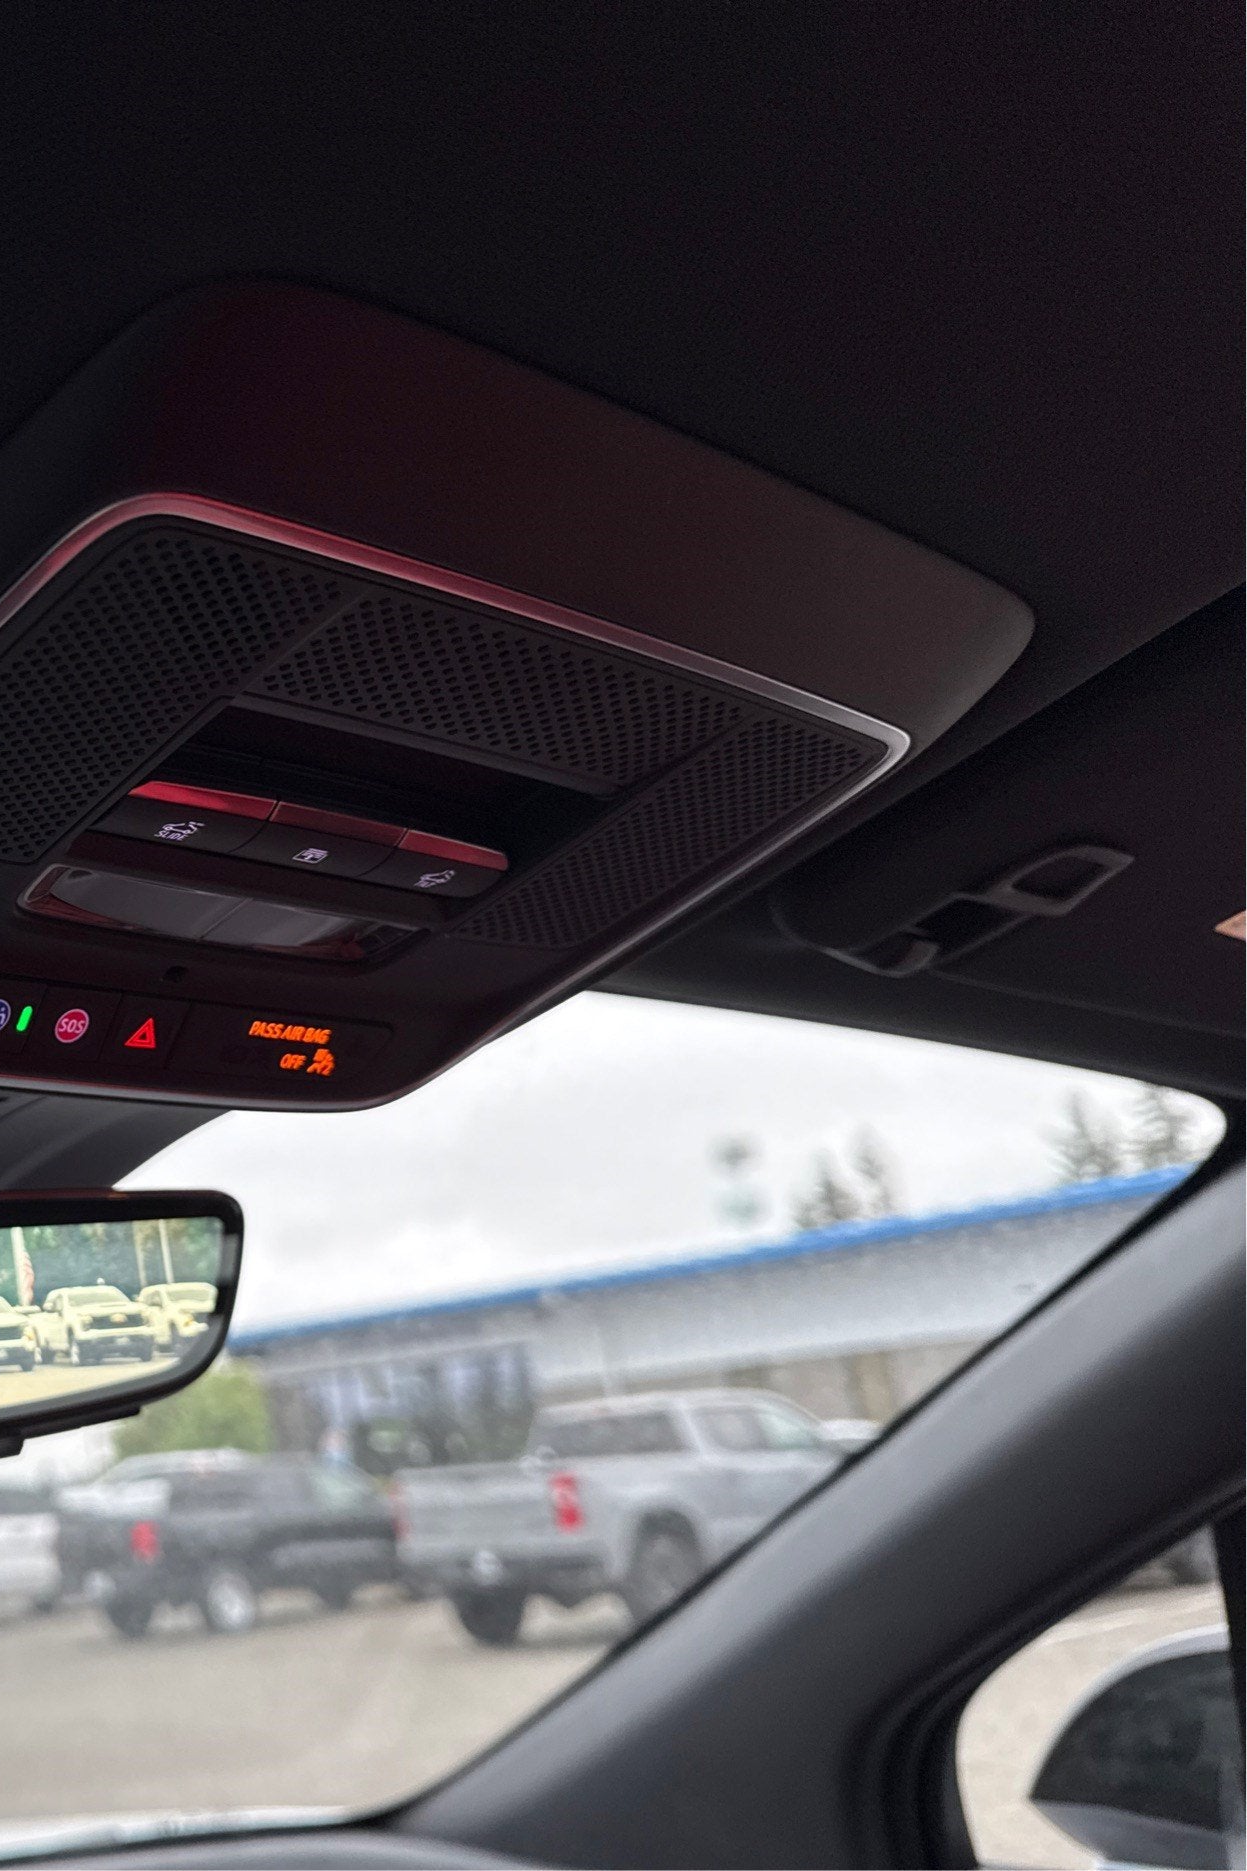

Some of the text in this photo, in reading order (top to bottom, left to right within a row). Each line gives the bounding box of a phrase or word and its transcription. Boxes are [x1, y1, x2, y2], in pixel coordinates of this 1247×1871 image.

[58, 1018, 86, 1034] SOS
[249, 1021, 331, 1045] PASS AIR BAG
[280, 1053, 307, 1070] OFF
